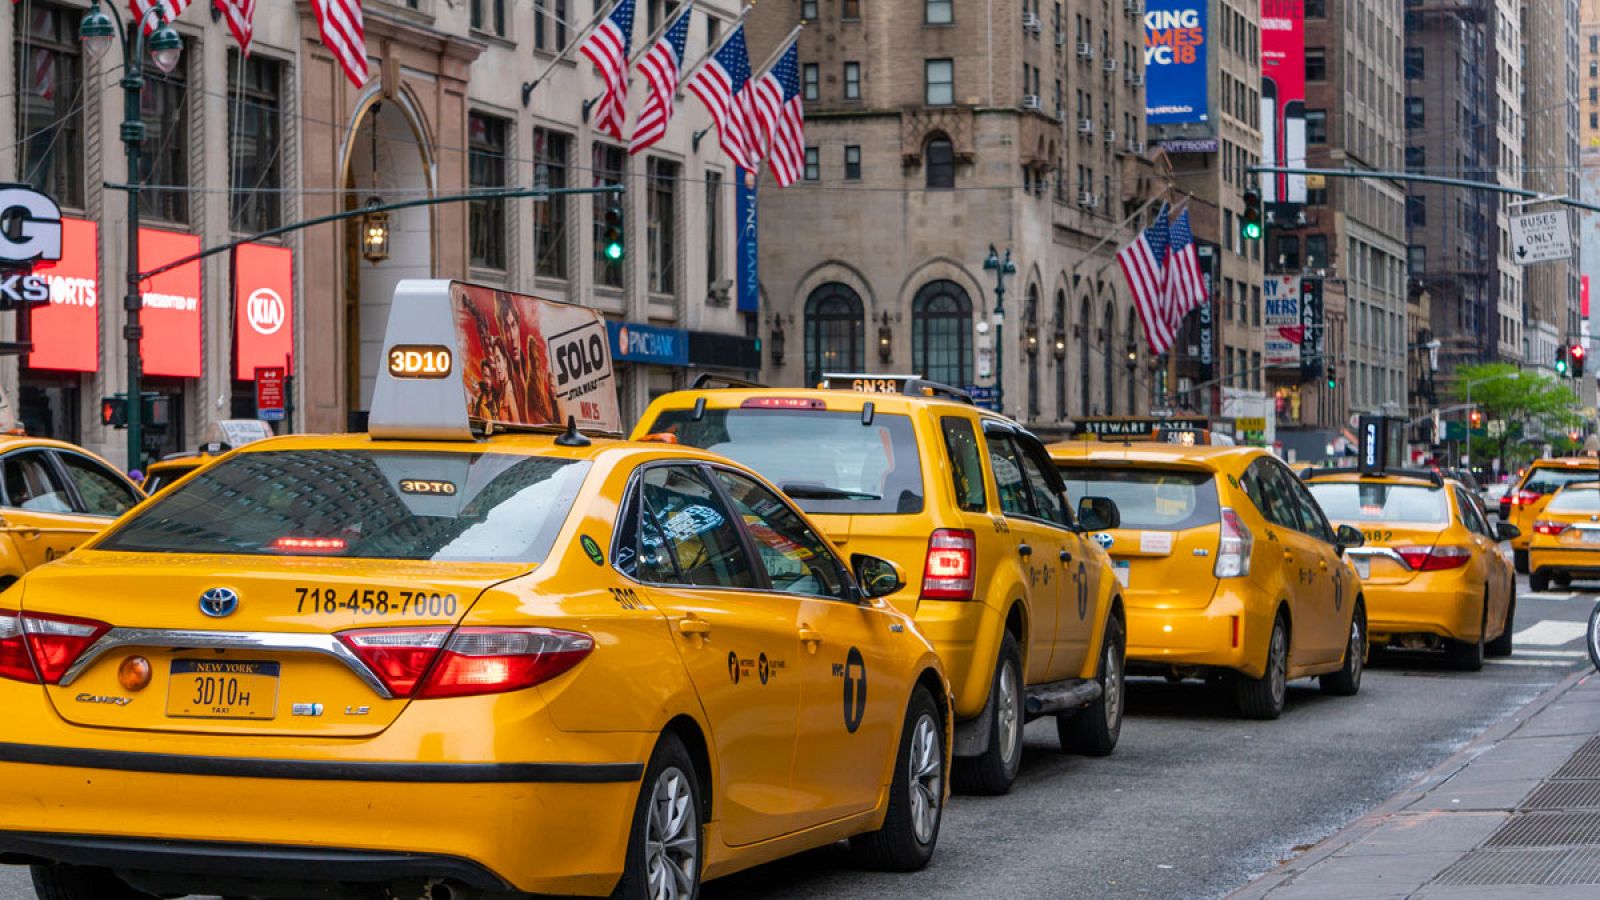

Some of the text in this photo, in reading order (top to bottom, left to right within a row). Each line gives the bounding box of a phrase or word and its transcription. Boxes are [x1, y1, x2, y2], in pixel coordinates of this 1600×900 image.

[1520, 214, 1557, 228] BUSES
[746, 194, 757, 297] PNC BANK
[1526, 232, 1554, 245] ONLY
[252, 298, 279, 324] KIA
[391, 351, 450, 373] 3D10
[556, 333, 604, 386] SOLO
[1086, 422, 1145, 434] STEWART
[295, 587, 458, 617] 718-458-7000
[197, 663, 253, 672] NEW YORK
